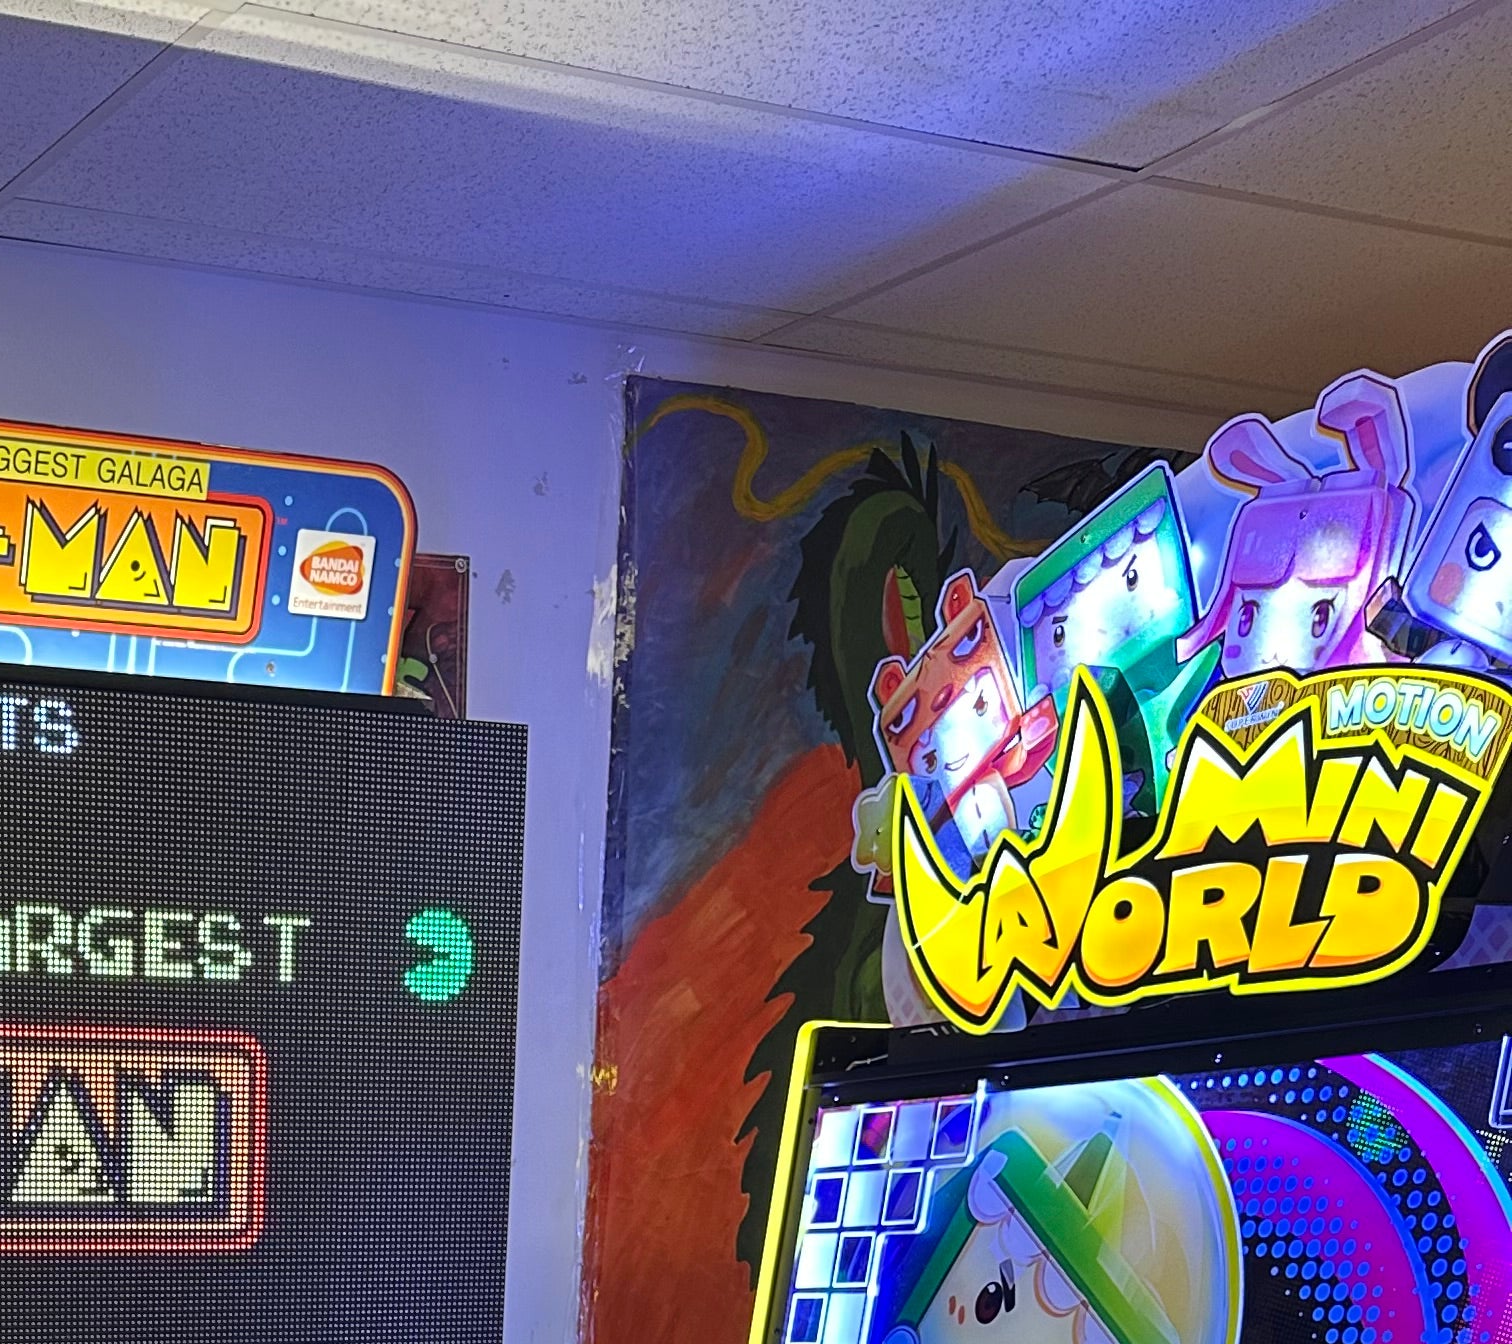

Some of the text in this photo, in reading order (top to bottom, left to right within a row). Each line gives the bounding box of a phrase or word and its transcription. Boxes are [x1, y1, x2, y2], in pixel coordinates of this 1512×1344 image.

[97, 457, 204, 493] GALAGA
[309, 571, 358, 587] NAMCO
[311, 556, 360, 573] BANDAI
[293, 597, 363, 614] Entertainment
[1326, 678, 1500, 760] MOTION
[1154, 720, 1468, 869] MINI
[902, 696, 1420, 1017] WORLD
